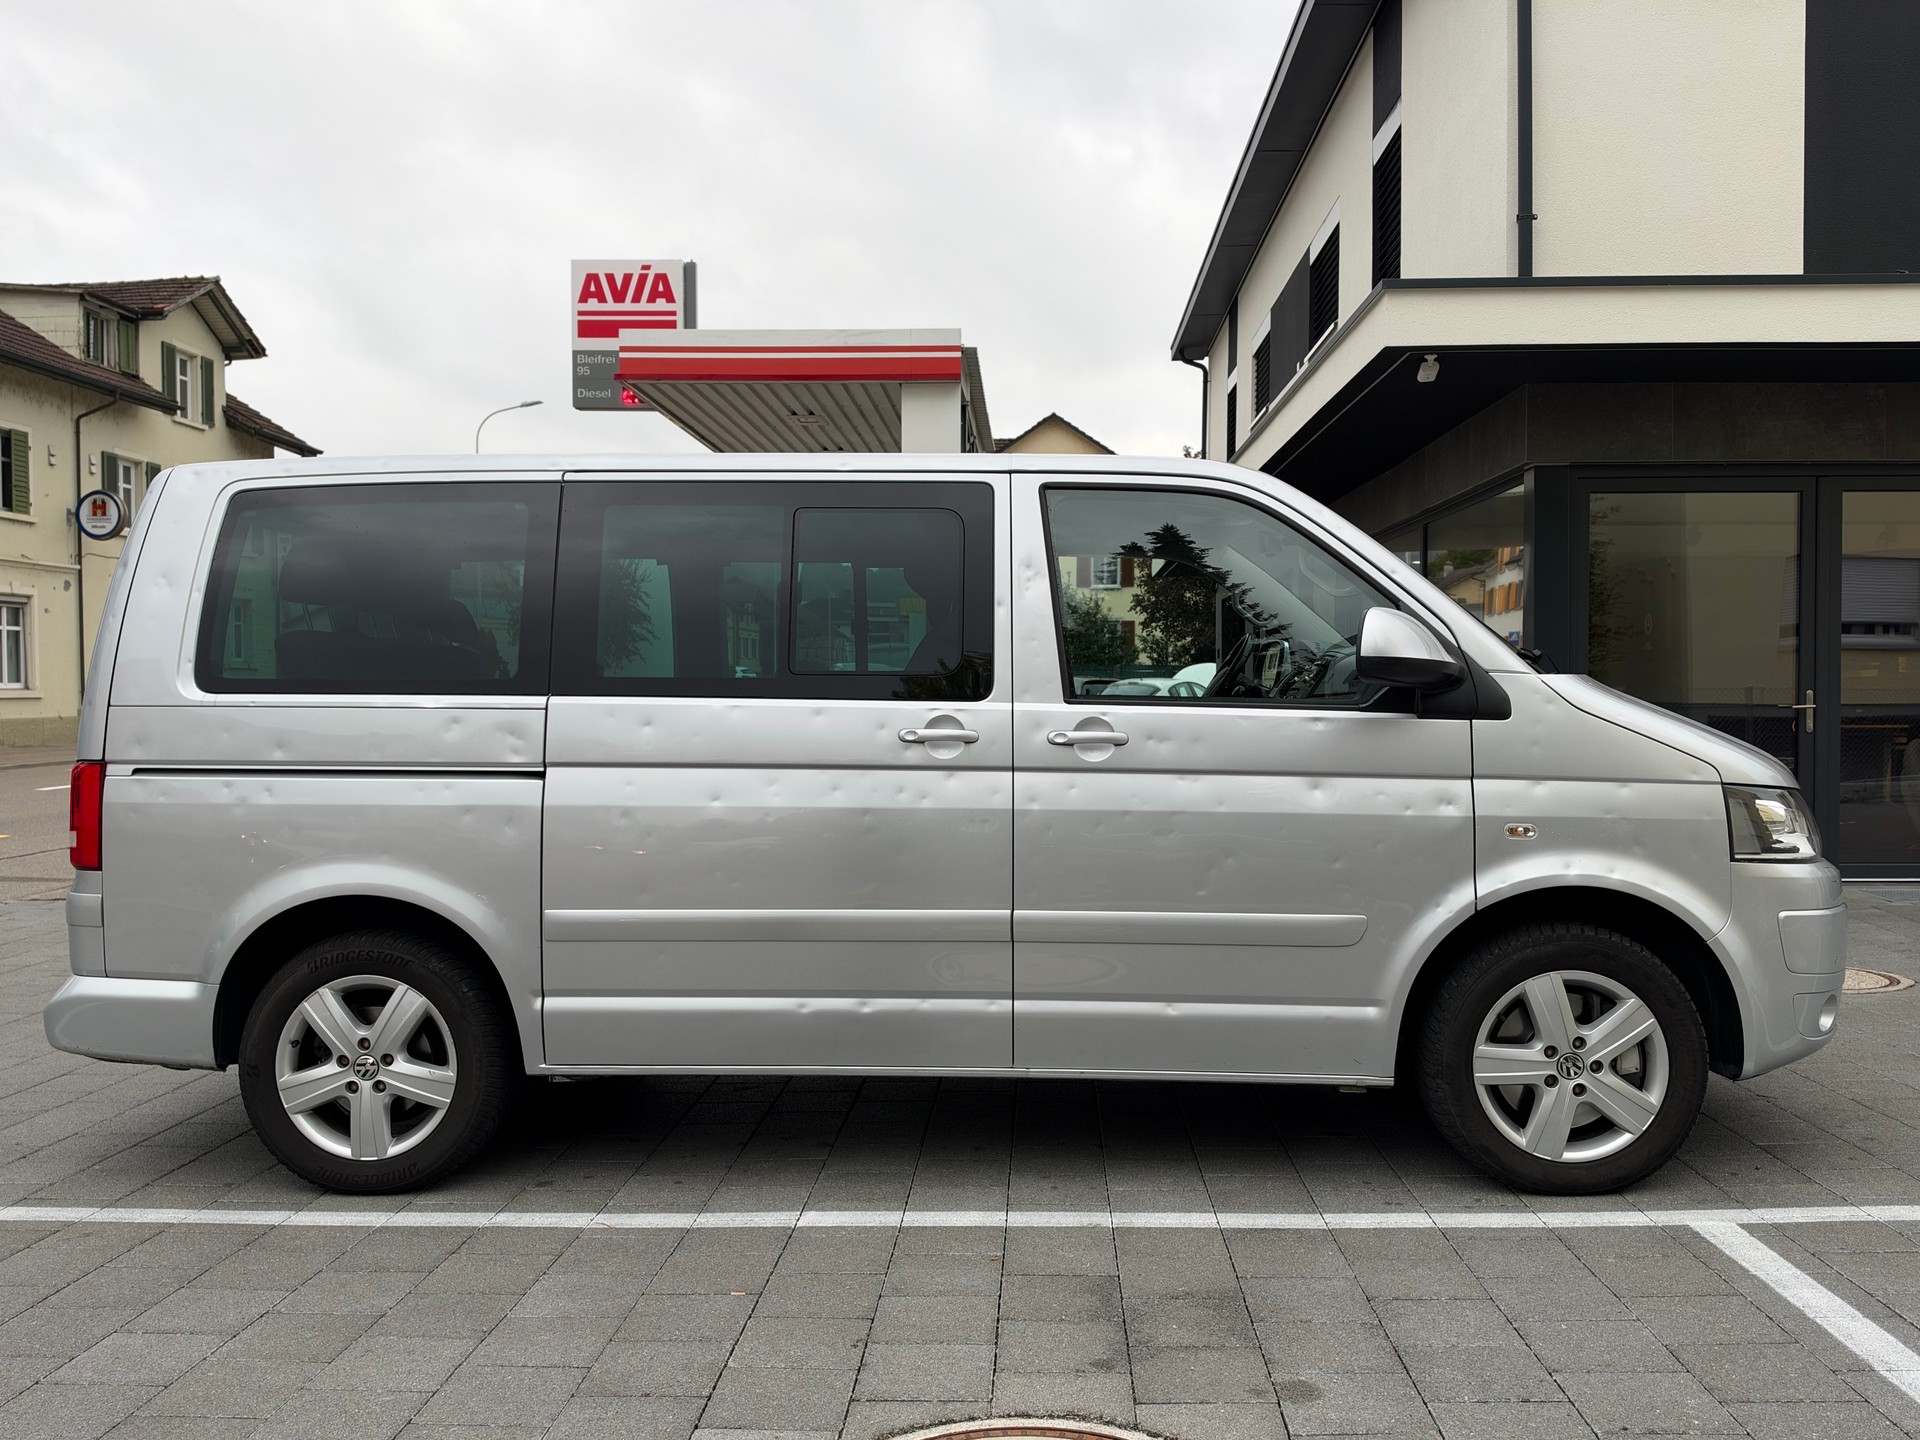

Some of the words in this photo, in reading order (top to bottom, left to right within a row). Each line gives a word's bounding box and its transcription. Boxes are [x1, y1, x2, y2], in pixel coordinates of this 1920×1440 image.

[577, 354, 616, 364] Bleifrei
[577, 366, 590, 376] 95
[577, 388, 611, 398] Diesel
[306, 950, 414, 976] BRIDGESTONE
